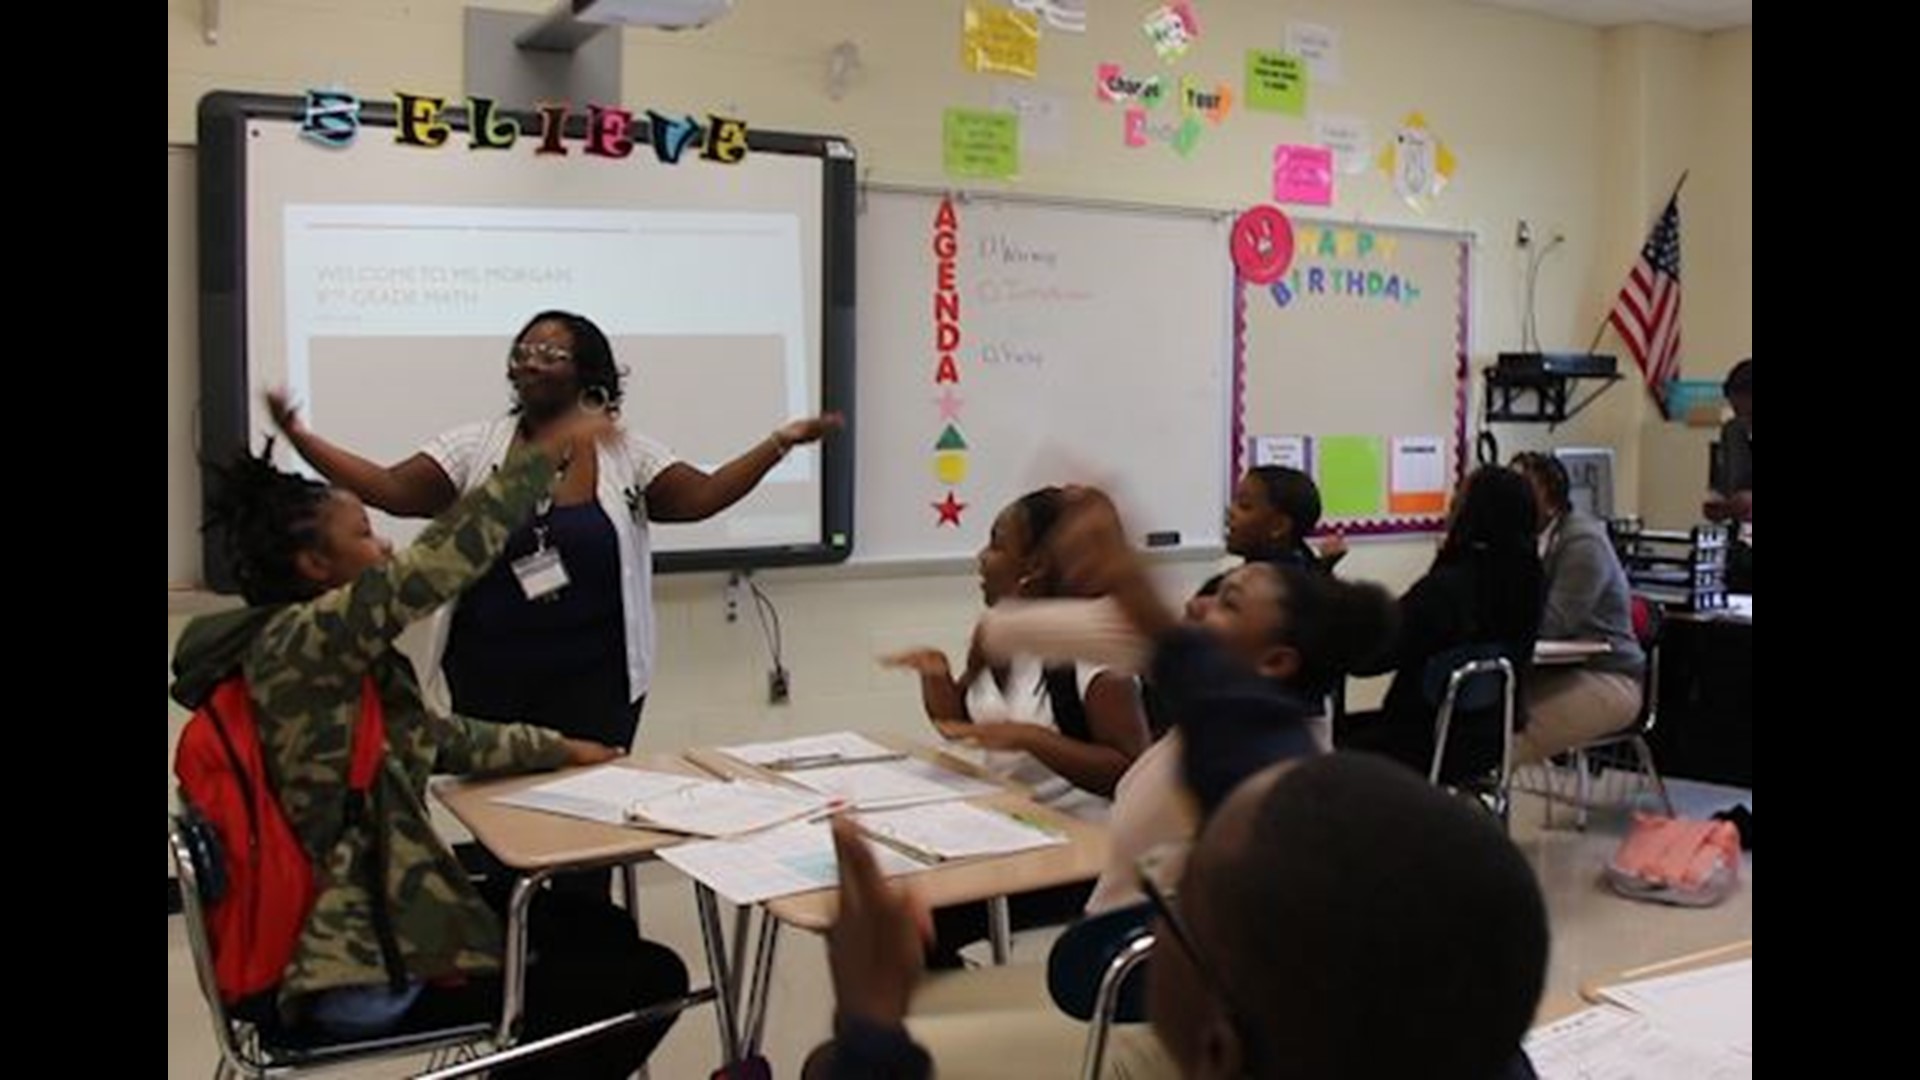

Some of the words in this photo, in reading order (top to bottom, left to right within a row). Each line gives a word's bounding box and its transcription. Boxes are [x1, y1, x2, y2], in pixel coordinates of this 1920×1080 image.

[301, 87, 749, 165] BELIEVE
[1297, 225, 1397, 256] HAPPY
[315, 265, 416, 284] WELCOME
[934, 196, 960, 384] AGENDA
[1270, 266, 1421, 307] BIRTHDAY
[353, 289, 416, 308] GRADE
[423, 290, 479, 308] MATH
